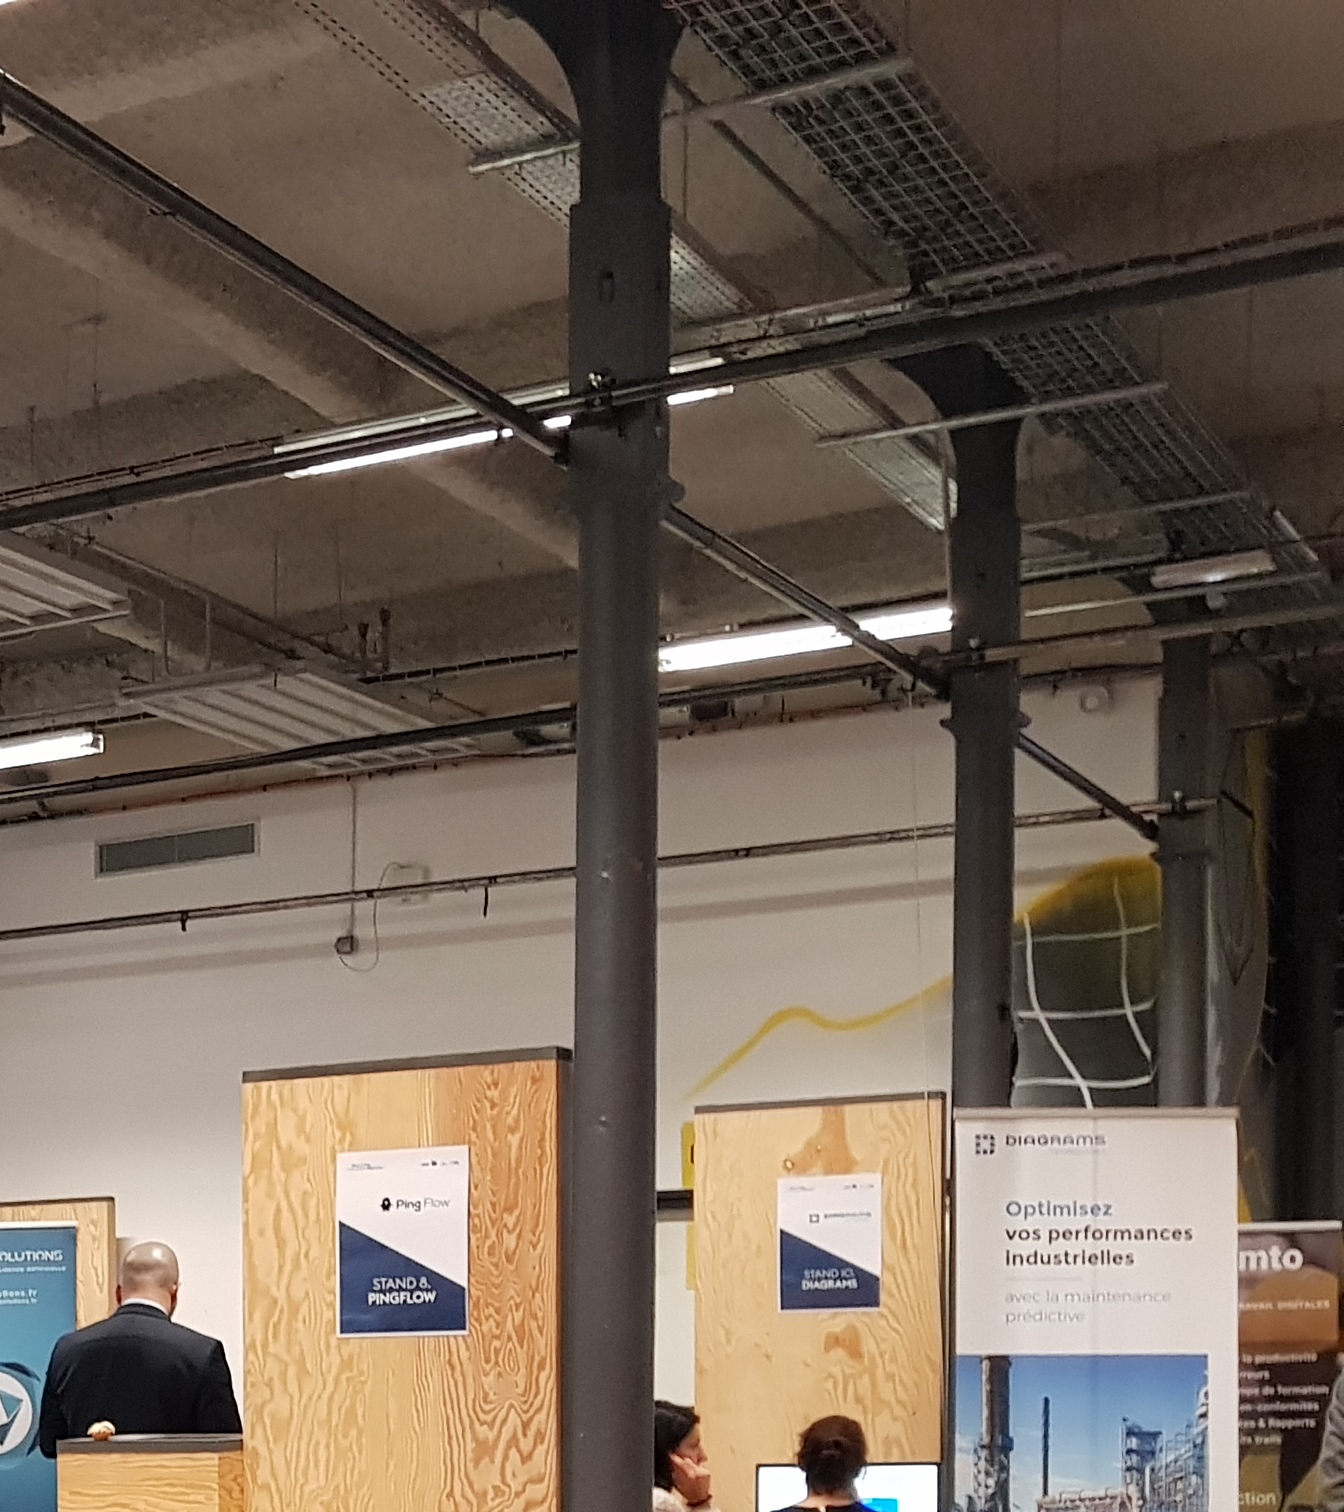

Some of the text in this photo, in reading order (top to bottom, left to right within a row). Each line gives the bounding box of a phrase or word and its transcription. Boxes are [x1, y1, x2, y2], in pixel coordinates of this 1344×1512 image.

[1006, 1134, 1107, 1147] DIAGRAMS
[1006, 1201, 1113, 1220] Optimisez
[1005, 1224, 1193, 1244] vos performances
[804, 1269, 839, 1279] STAND
[373, 1276, 431, 1291] STAND 8.
[802, 1279, 858, 1291] DIAGRAMS
[368, 1291, 436, 1306] PINGFLOW
[1005, 1289, 1172, 1303] avec la maintenance
[1006, 1308, 1085, 1325] prédictive
